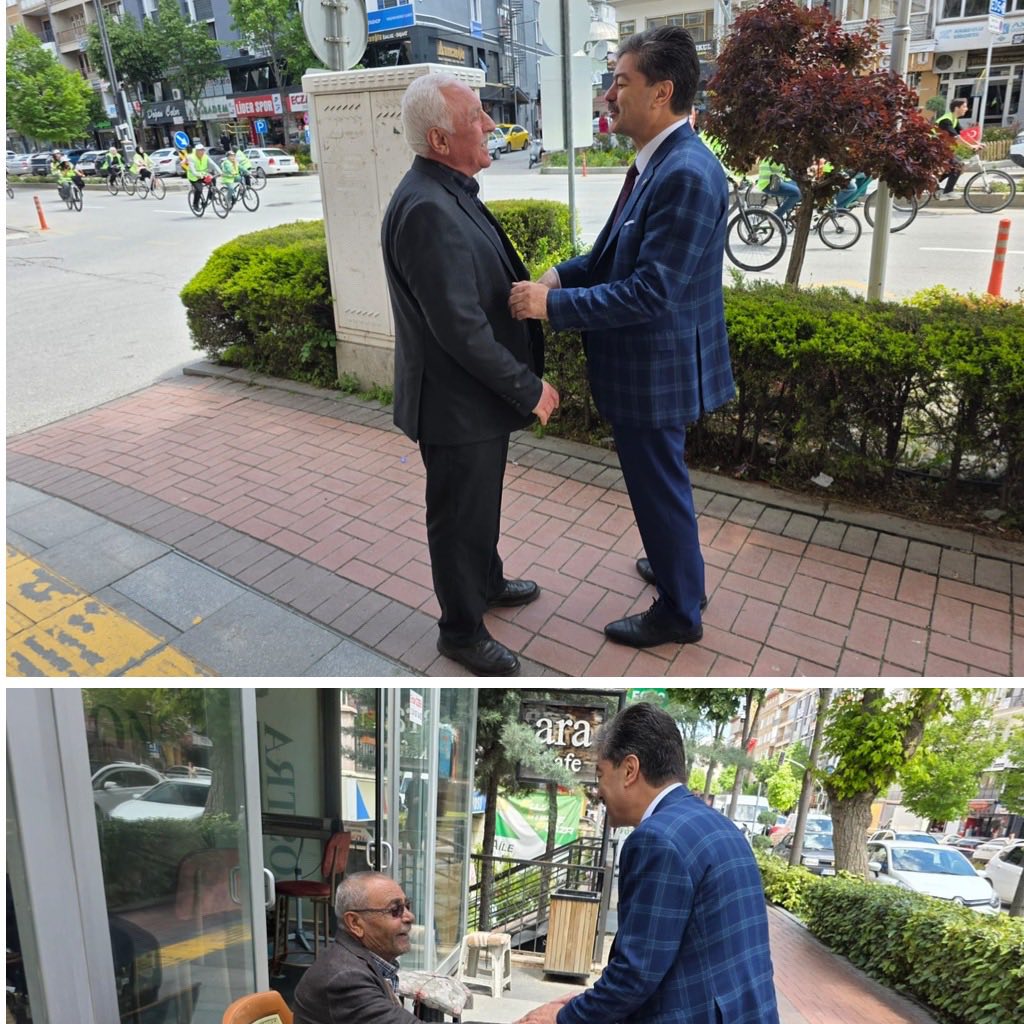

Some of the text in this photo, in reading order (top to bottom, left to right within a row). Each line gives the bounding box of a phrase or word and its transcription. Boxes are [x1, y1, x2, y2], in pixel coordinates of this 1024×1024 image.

[236, 99, 274, 114] LİDER SPOR
[535, 716, 593, 748] ara
[553, 753, 582, 772] afe
